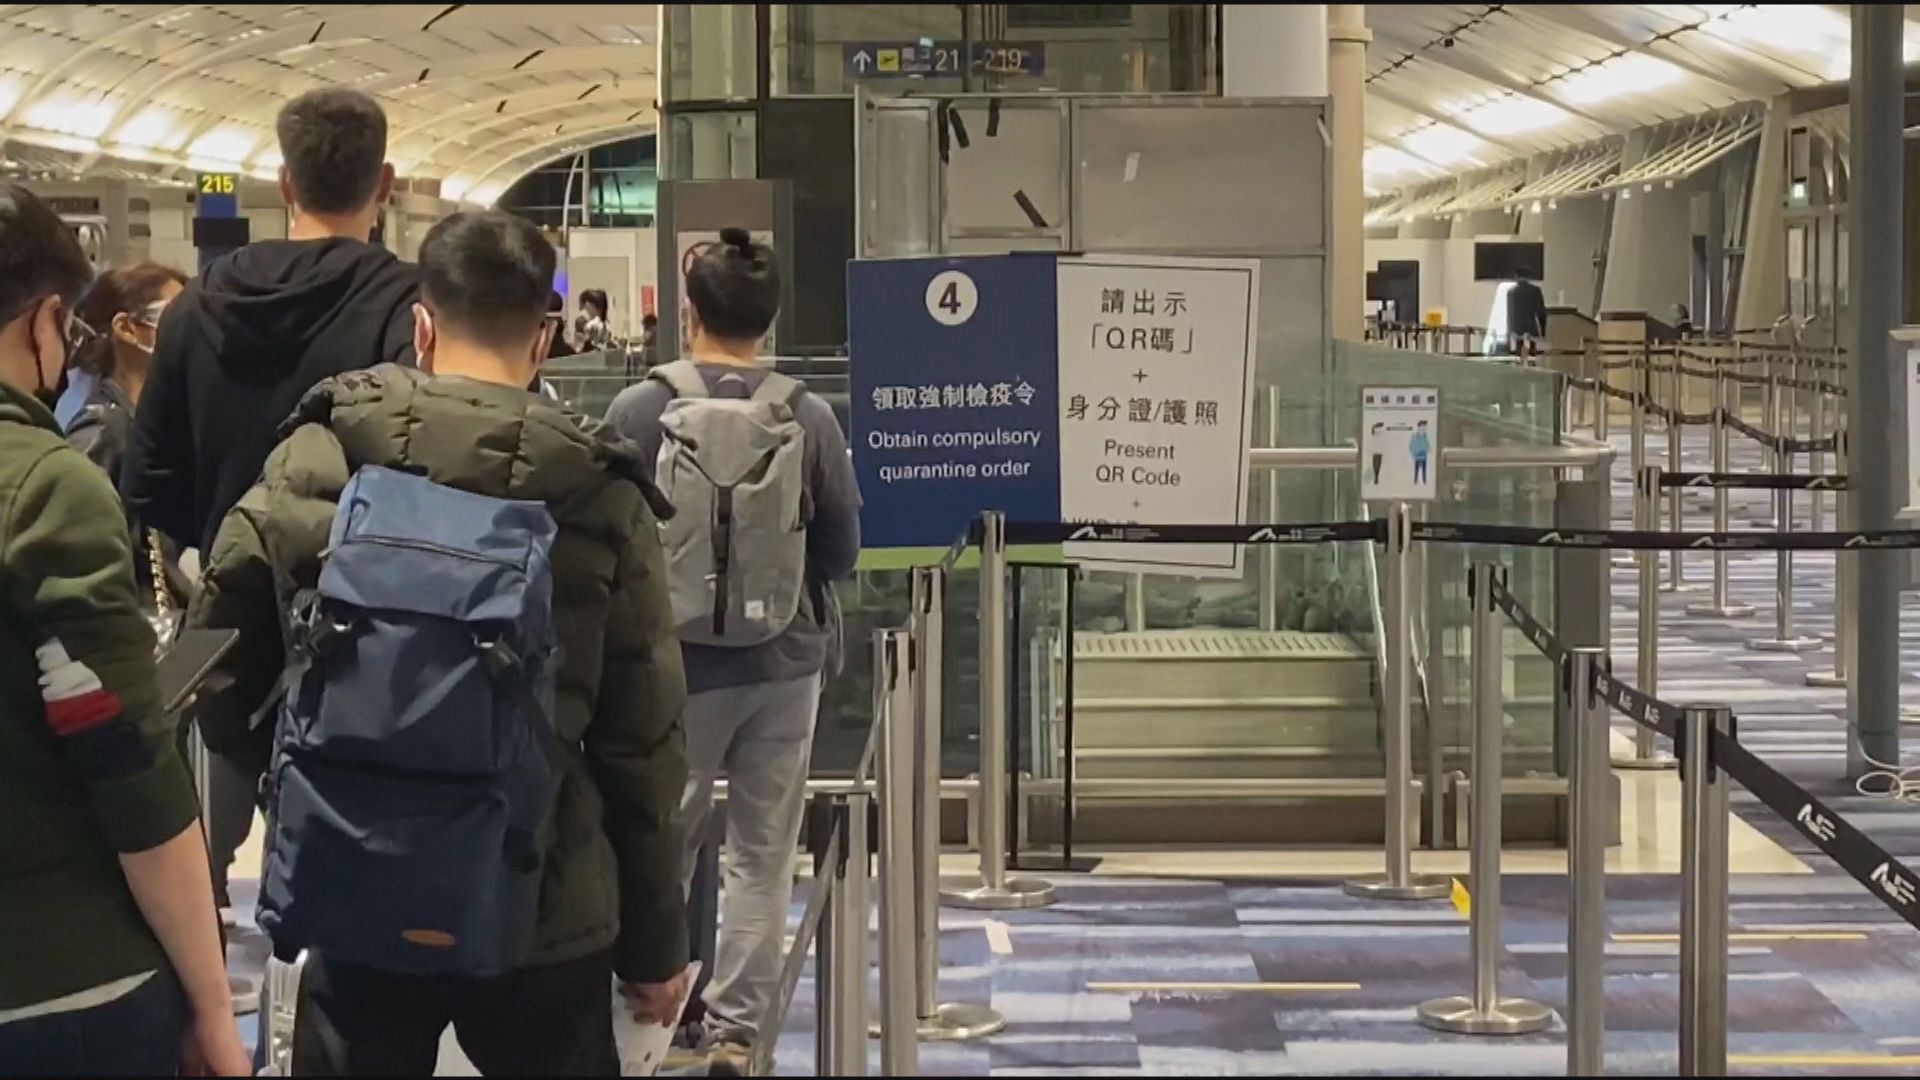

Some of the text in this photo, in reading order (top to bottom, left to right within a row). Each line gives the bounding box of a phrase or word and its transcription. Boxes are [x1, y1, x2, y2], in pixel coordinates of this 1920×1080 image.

[202, 175, 234, 193] 215
[939, 282, 961, 315] 4
[1101, 288, 1187, 316] 請出示
[872, 381, 1036, 410] 領取強制檢疫令
[1066, 394, 1218, 426] 身分證/護照
[868, 427, 1041, 449] Obtain compulsory
[1104, 439, 1175, 459] Present
[879, 459, 1031, 483] quarantine order
[1096, 465, 1180, 486] QR Code
